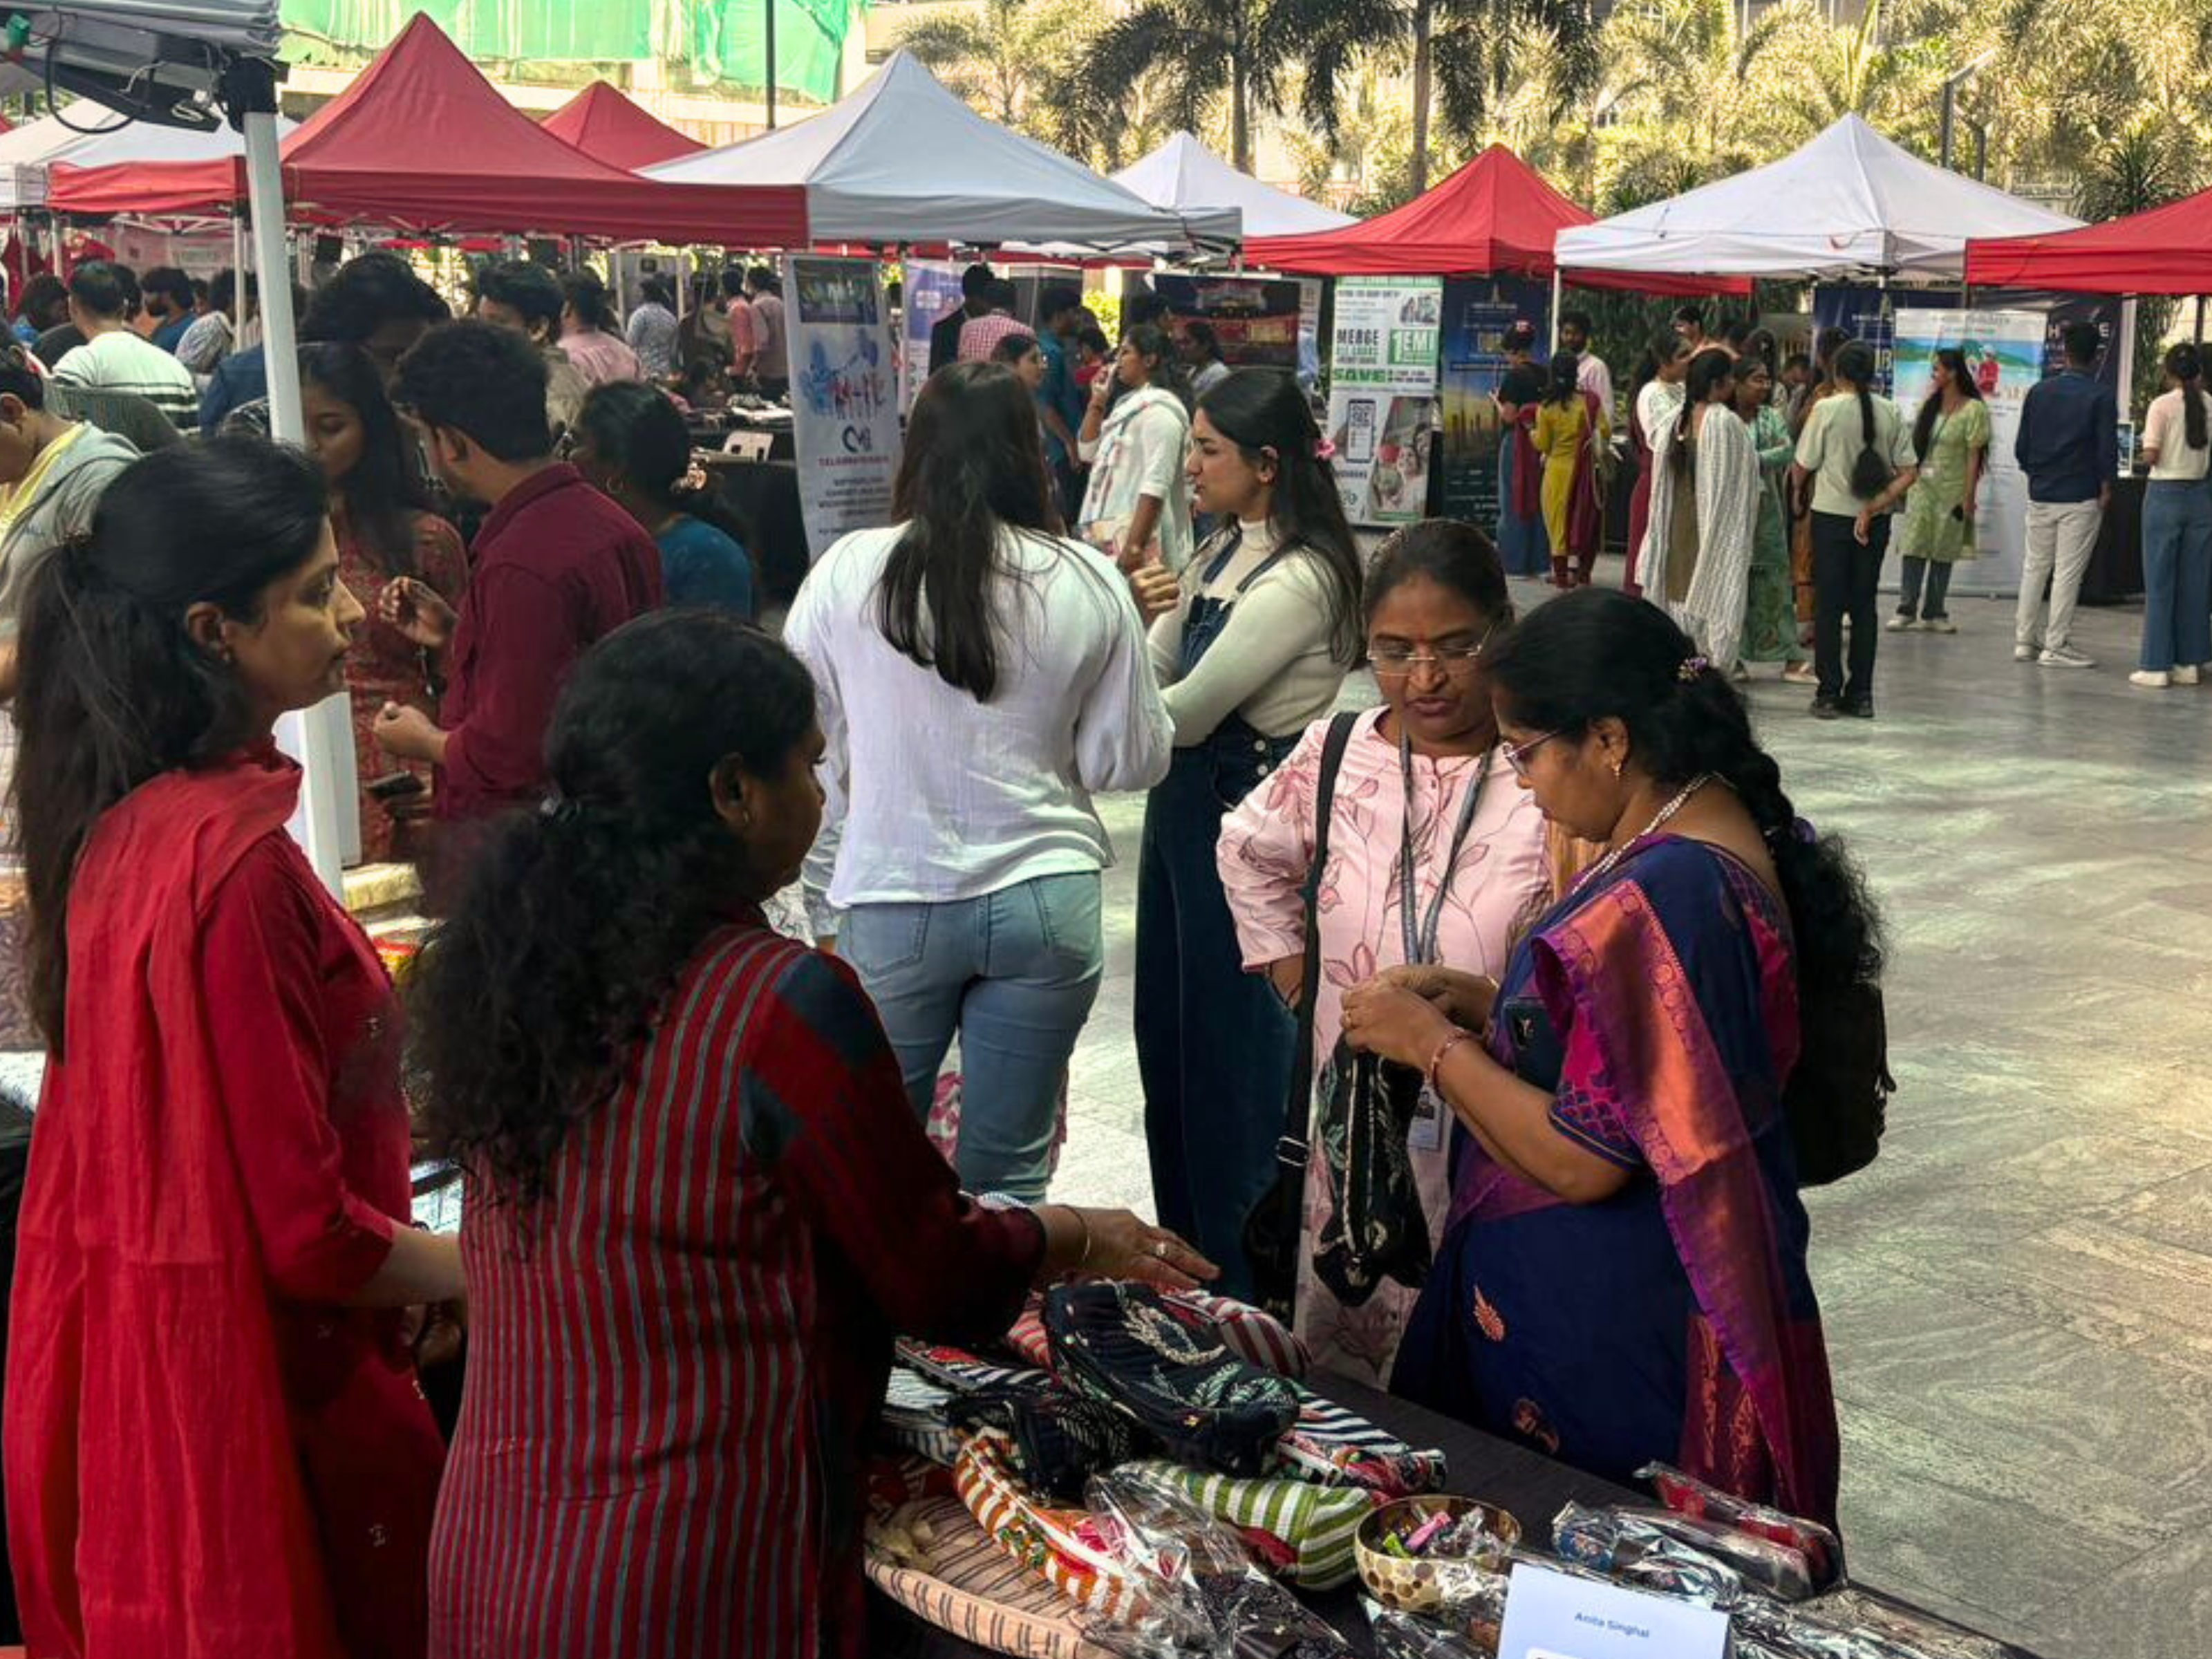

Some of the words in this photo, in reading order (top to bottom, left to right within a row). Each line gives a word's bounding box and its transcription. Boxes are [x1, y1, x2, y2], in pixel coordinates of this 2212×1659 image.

[1336, 328, 1379, 345] MERGE
[1391, 330, 1402, 362] 1
[1403, 330, 1436, 351] EMI
[1333, 368, 1386, 383] SAVE
[1574, 1611, 1605, 1627] Anita
[1607, 1620, 1650, 1638] Singhal
